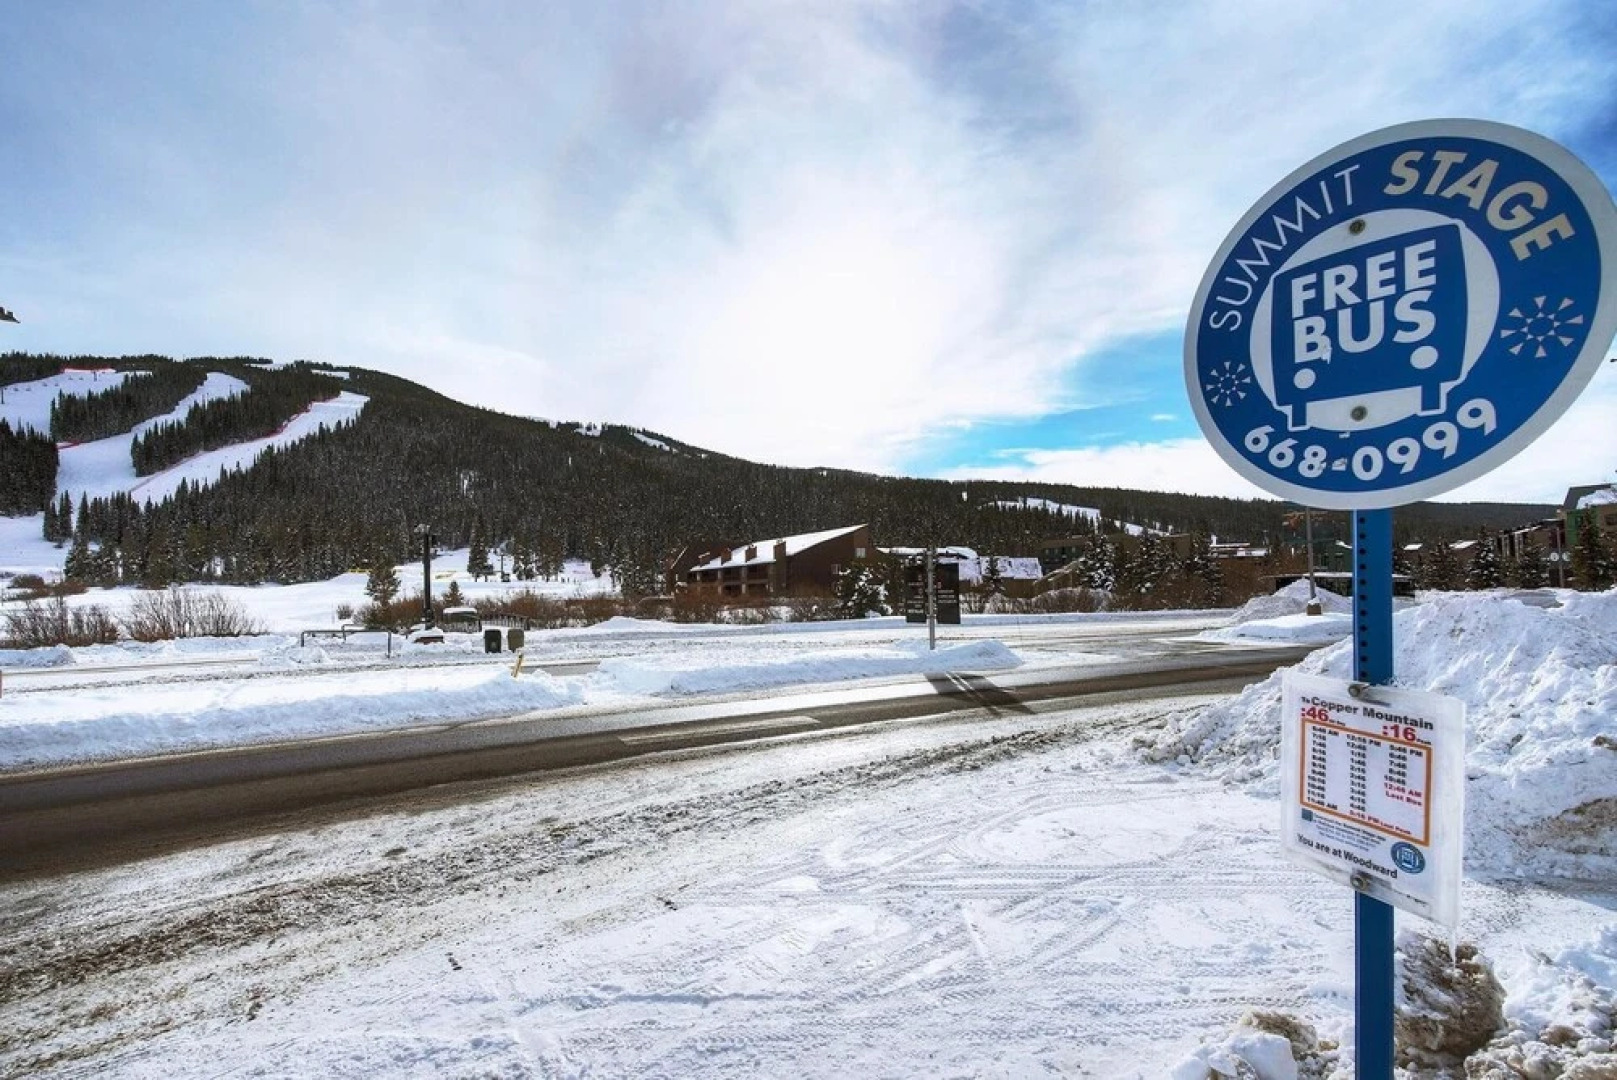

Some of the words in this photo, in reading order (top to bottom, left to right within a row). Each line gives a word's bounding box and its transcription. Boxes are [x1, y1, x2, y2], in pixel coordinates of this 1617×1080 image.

[1209, 164, 1360, 331] SUMMIT
[1383, 150, 1576, 261] STAGE
[1291, 239, 1437, 318] FREE
[1293, 290, 1437, 364] BUS
[1244, 398, 1497, 481] 668-0999
[1301, 706, 1329, 721] :46
[1311, 697, 1358, 714] Copper
[1362, 706, 1434, 730] Mountain
[1383, 724, 1416, 741] :16
[1297, 833, 1313, 847] You
[1315, 842, 1330, 854] are
[1332, 848, 1342, 857] at
[1343, 850, 1397, 879] Woodward
